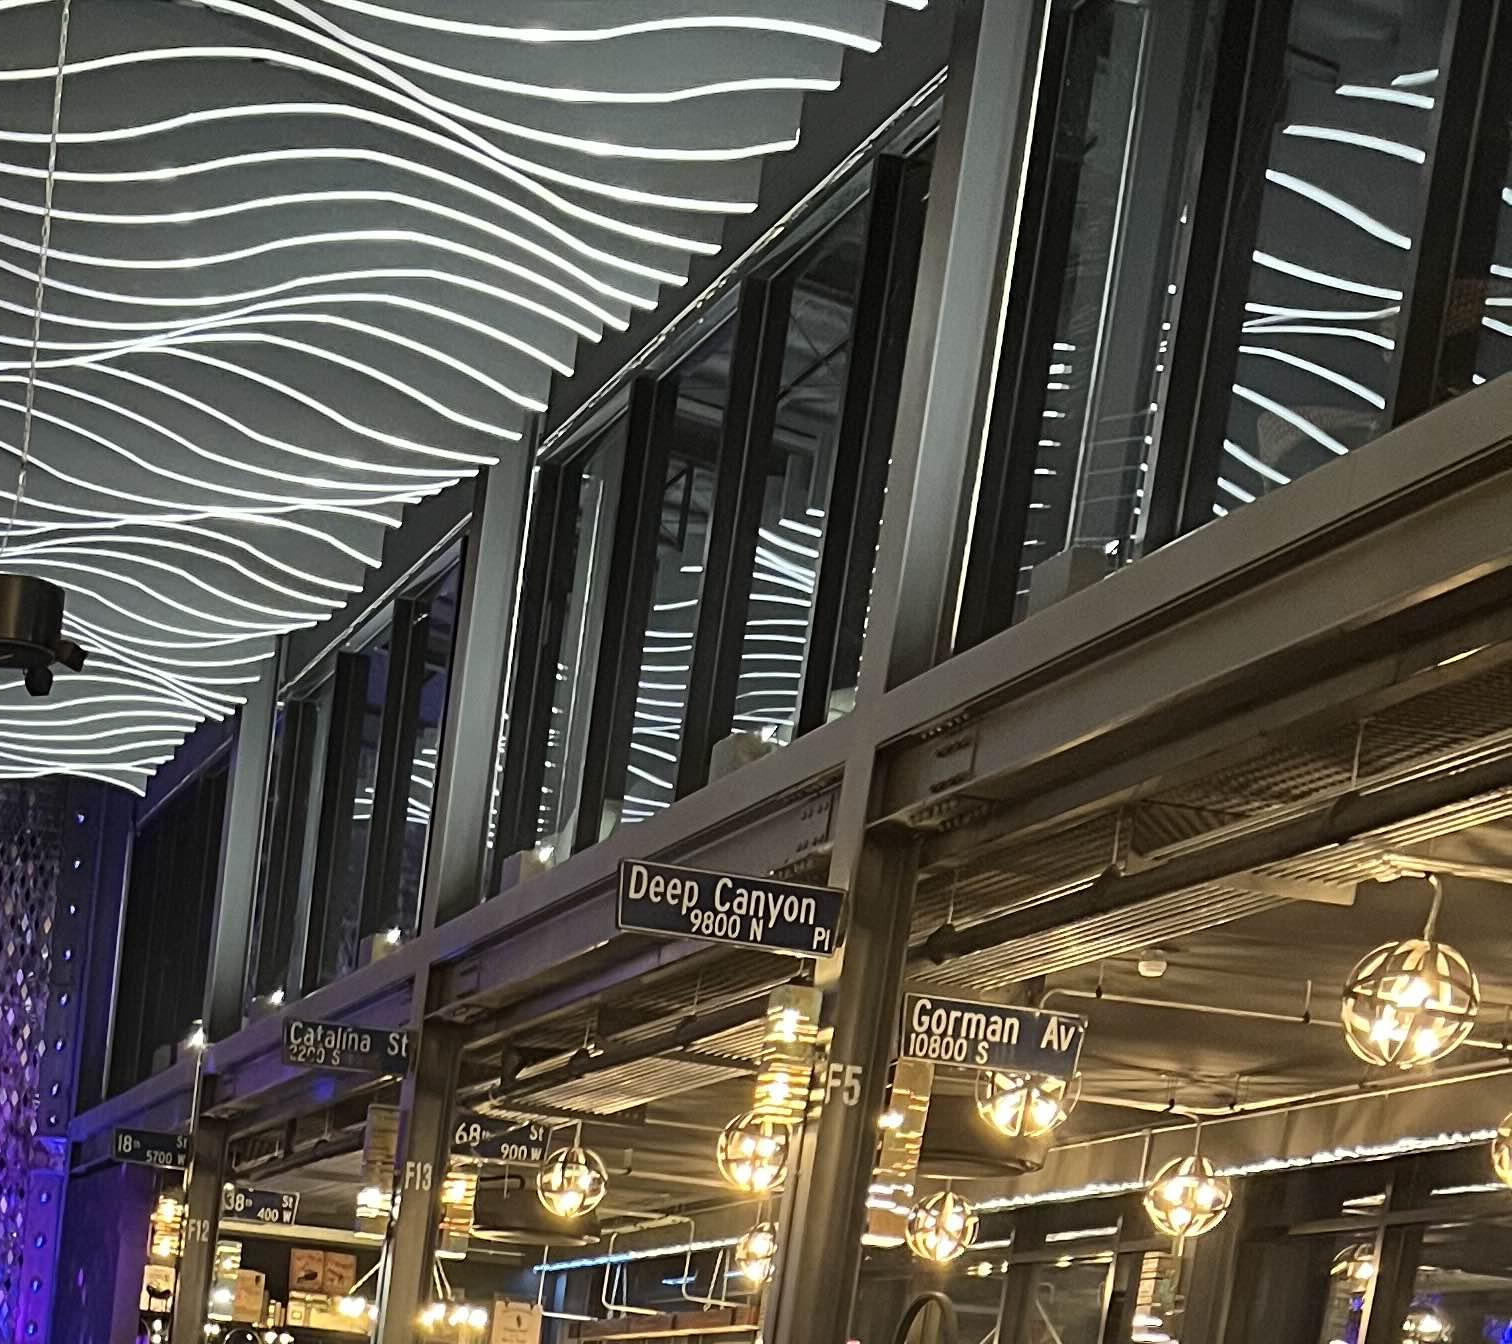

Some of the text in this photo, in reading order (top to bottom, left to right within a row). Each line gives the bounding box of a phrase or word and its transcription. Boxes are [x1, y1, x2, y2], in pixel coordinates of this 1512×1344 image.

[628, 865, 816, 929] Deep Canyon
[690, 908, 830, 951] 9800 N Pl
[912, 998, 1075, 1051] Gorman Av
[289, 1021, 408, 1058] Catalina St
[909, 1033, 989, 1064] 10800 S
[332, 1050, 341, 1066] S
[825, 1062, 863, 1106] F5
[529, 1129, 544, 1142] St
[146, 1150, 173, 1165] 5700
[500, 1143, 541, 1161] 900 W
[405, 1161, 432, 1190] F13
[282, 1195, 294, 1209] St
[256, 1208, 292, 1223] 400 W
[188, 1218, 209, 1242] F12
